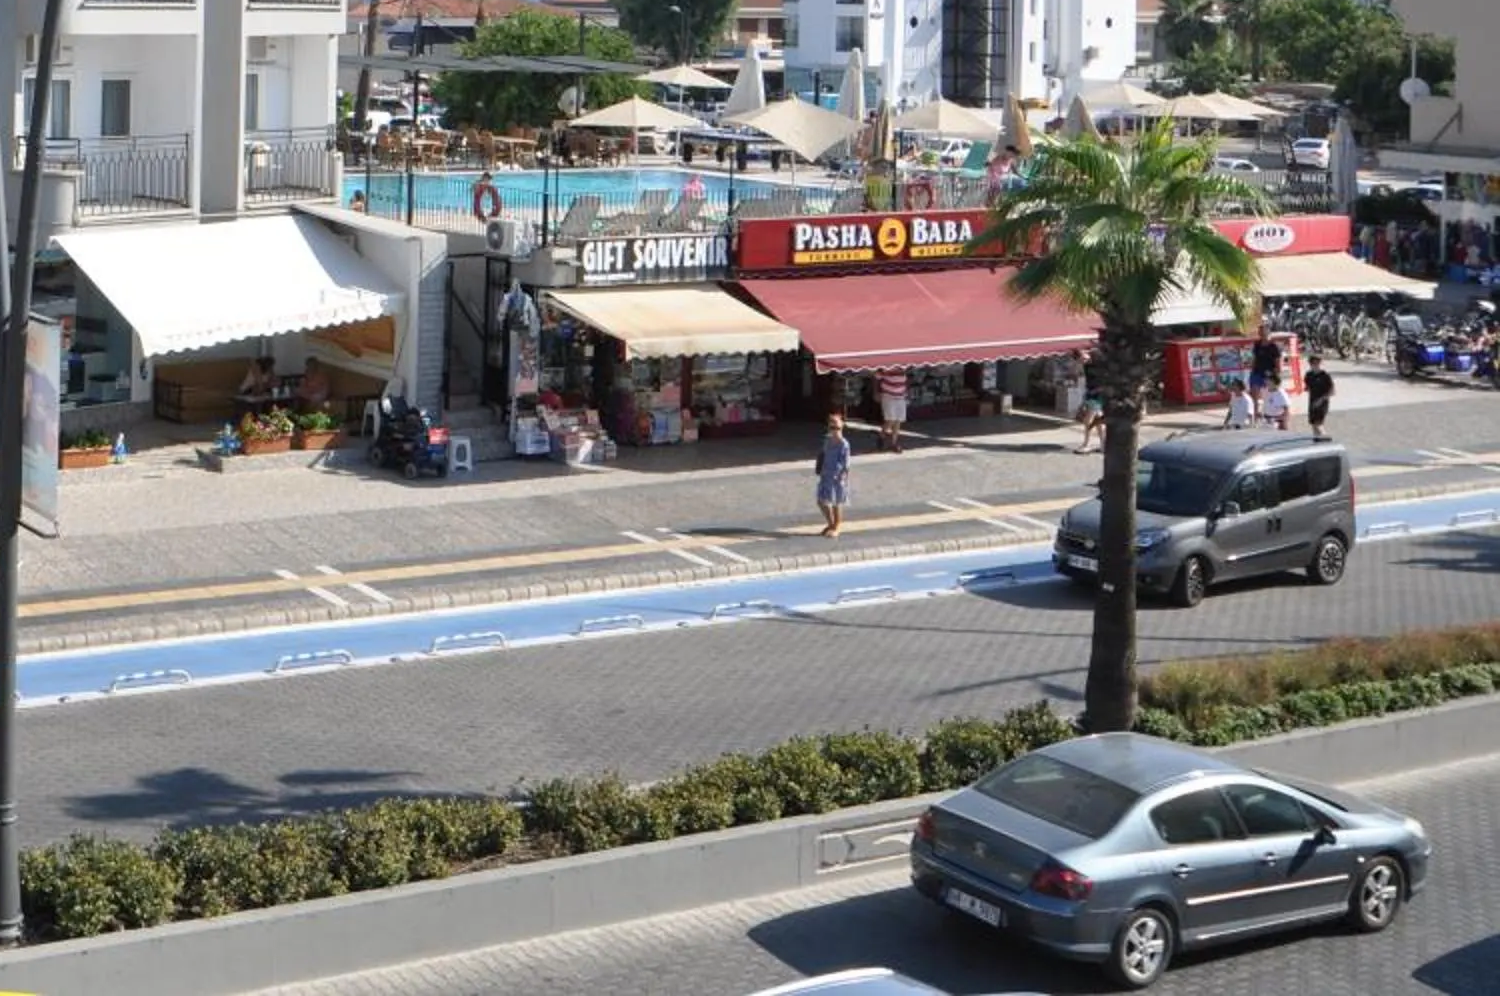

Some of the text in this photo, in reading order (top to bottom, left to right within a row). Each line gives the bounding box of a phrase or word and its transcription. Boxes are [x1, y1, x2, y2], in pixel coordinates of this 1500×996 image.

[794, 217, 972, 250] PASHA BABA
[582, 237, 729, 272] GIFT SOUVENIR
